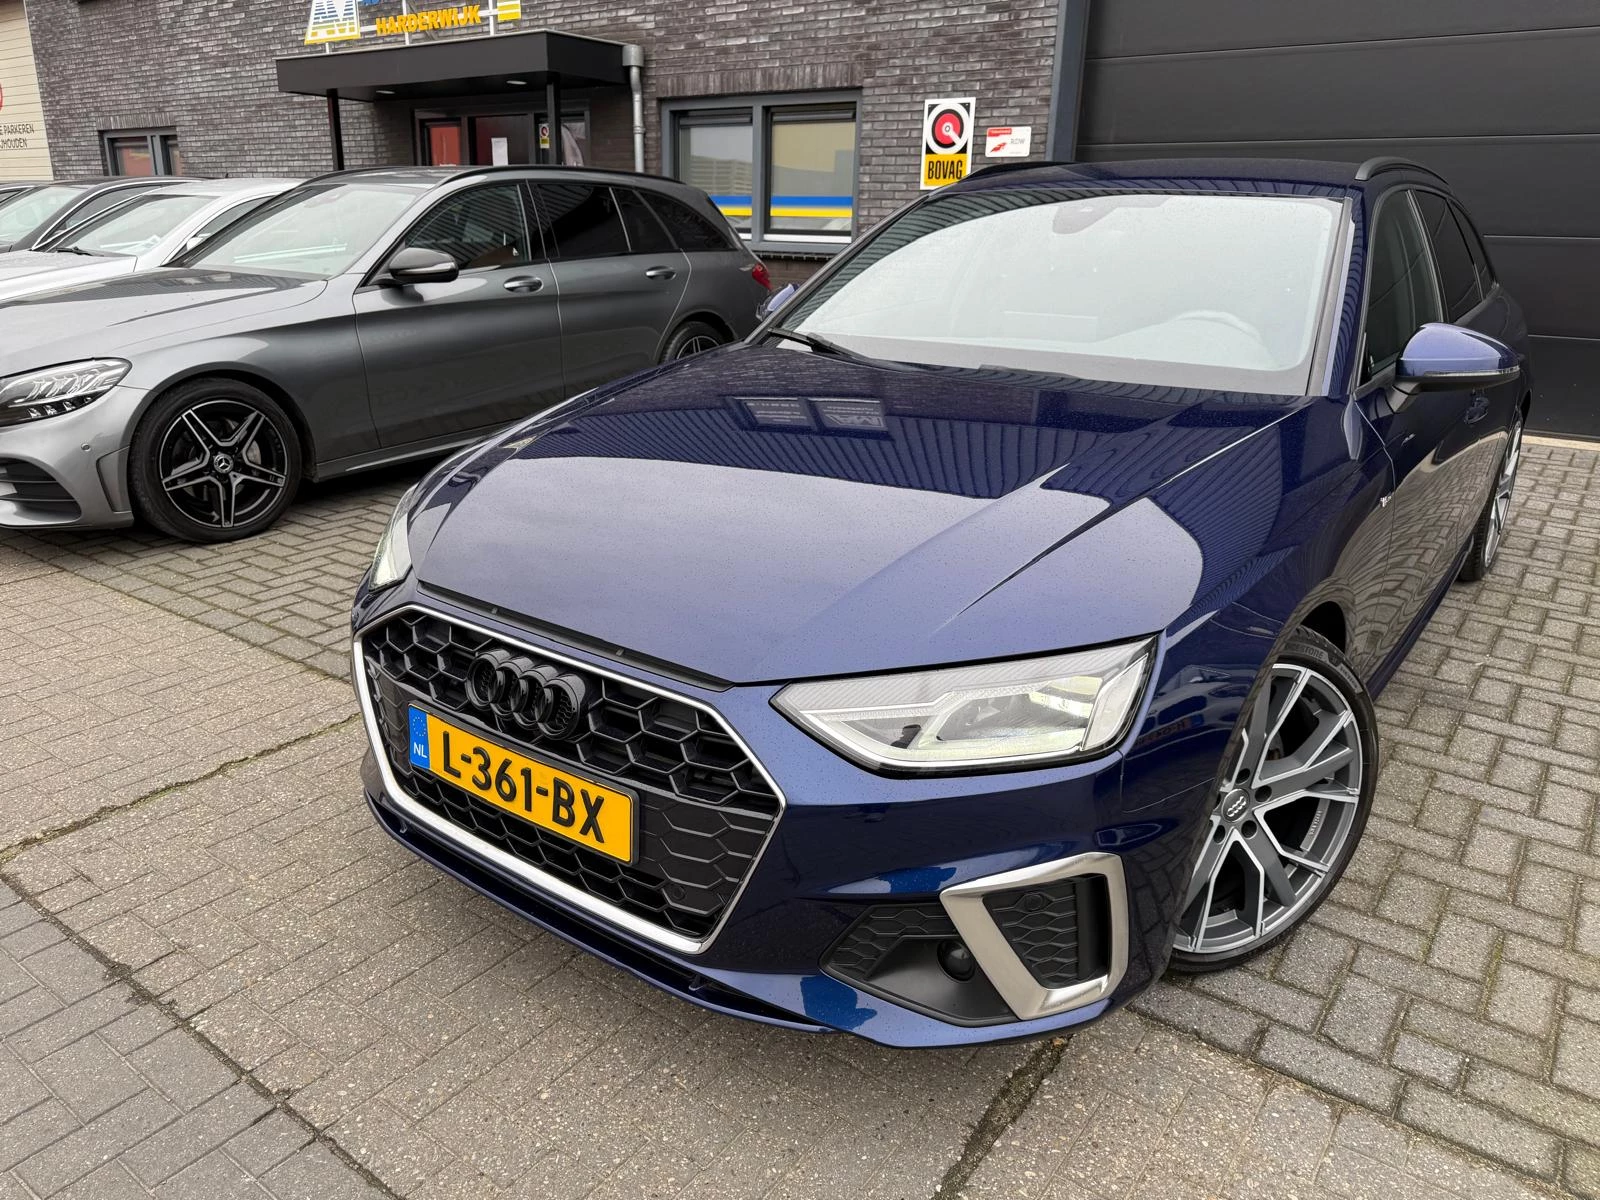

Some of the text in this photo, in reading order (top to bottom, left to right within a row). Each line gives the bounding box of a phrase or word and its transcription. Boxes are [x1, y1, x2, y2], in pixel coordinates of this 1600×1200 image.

[376, 5, 481, 35] HARDERWIJK
[4, 124, 34, 134] PARKEREN
[927, 160, 962, 180] BOVAG
[413, 742, 427, 758] NL
[442, 730, 605, 843] L-361-BX
